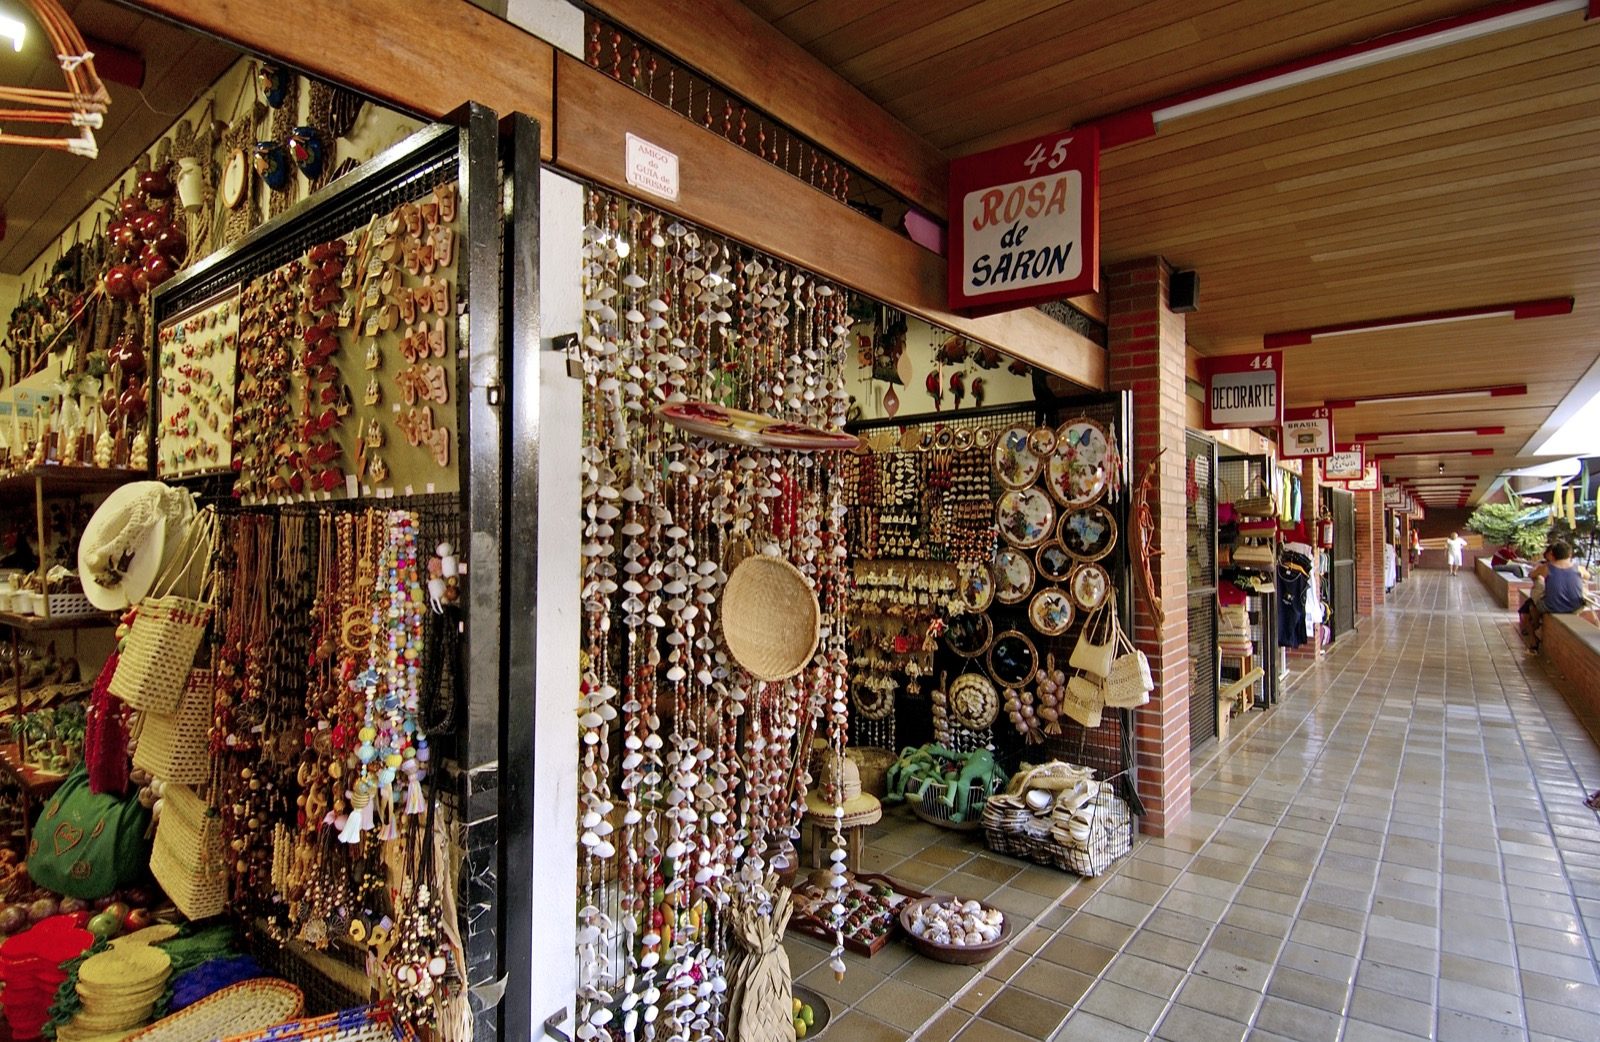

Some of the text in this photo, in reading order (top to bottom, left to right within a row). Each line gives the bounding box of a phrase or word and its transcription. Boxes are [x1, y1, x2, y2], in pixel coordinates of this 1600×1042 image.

[638, 145, 669, 164] AMIGO
[1023, 136, 1074, 174] 45
[633, 173, 674, 195] TURISMO
[636, 164, 670, 184] GUIA de
[972, 176, 1067, 232] ROSA
[1000, 220, 1029, 249] de
[971, 241, 1073, 287] SARON
[1249, 355, 1273, 369] 44
[1212, 384, 1275, 410] DECORARTE
[1312, 408, 1329, 418] 43
[1350, 444, 1361, 452] 42
